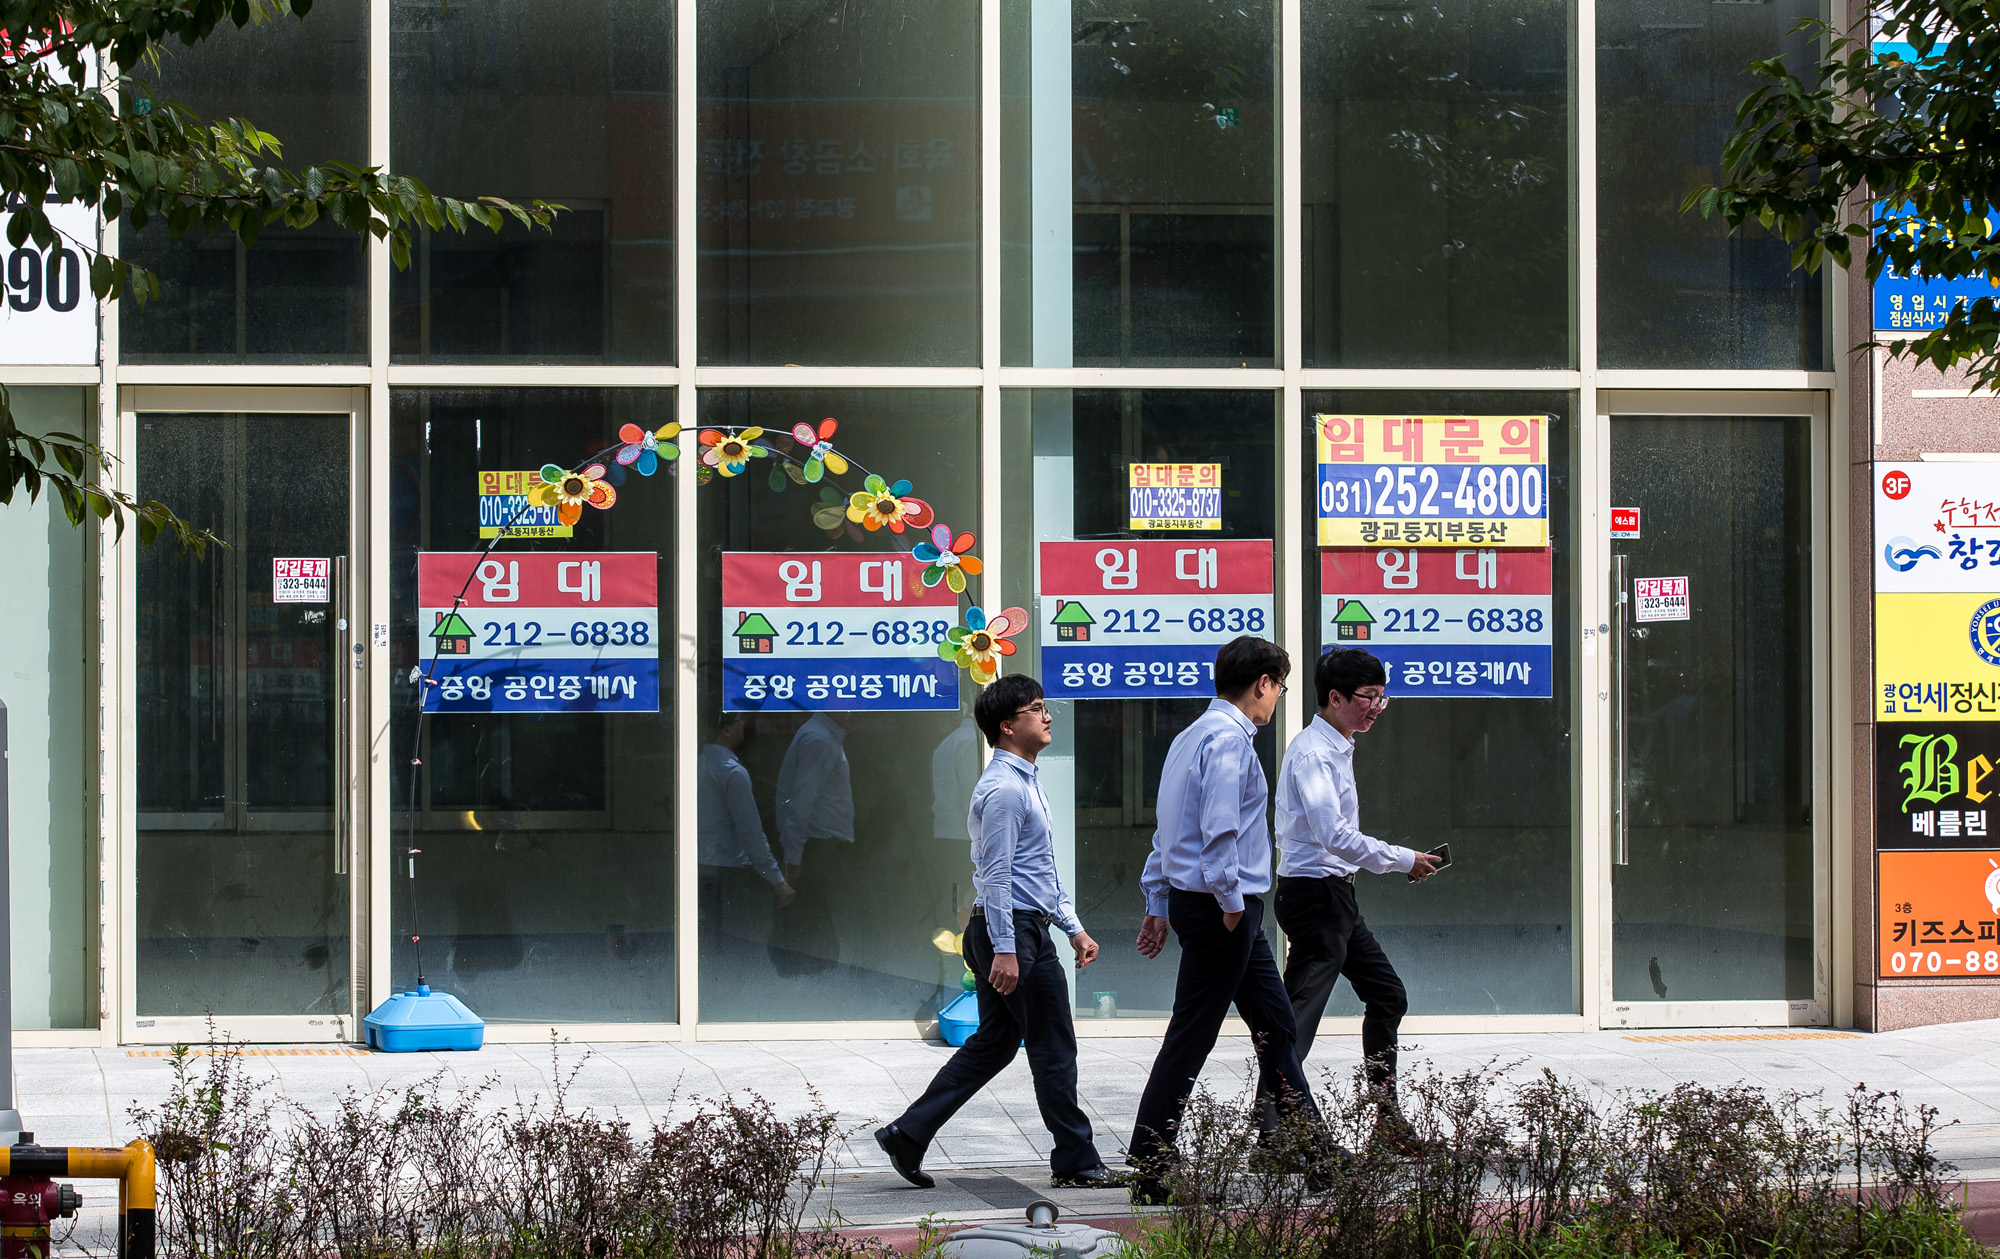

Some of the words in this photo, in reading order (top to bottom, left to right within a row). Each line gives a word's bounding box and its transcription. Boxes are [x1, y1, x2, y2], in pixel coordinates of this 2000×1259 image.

[0, 248, 80, 312] 90
[1889, 311, 1935, 327] 점심식사
[1885, 477, 1909, 495] 3F
[1130, 487, 1220, 518] 010-3325-8737
[1360, 521, 1508, 543] 광교둥지부동산
[1614, 516, 1636, 526] 에스원
[276, 560, 327, 577] 한길목재
[282, 578, 326, 590] 323-6444
[1637, 578, 1686, 597] 한길목재
[1644, 596, 1686, 609] 323-6444
[1103, 607, 1266, 633] 212-6838
[1383, 607, 1544, 633] 212-6838
[483, 621, 650, 647] 212-6838
[786, 620, 950, 646] 212-6838
[1062, 662, 1114, 688] 중앙
[1402, 661, 1532, 686] 공인중개사
[440, 676, 493, 700] 중앙
[503, 675, 638, 700] 공인중개사
[743, 675, 796, 700] 중앙
[805, 673, 939, 700] 공인중개사
[1899, 682, 2000, 714] 연세정신
[1898, 733, 2000, 814] Be
[1911, 809, 1987, 837] 베를린
[1894, 901, 1913, 914] 3층
